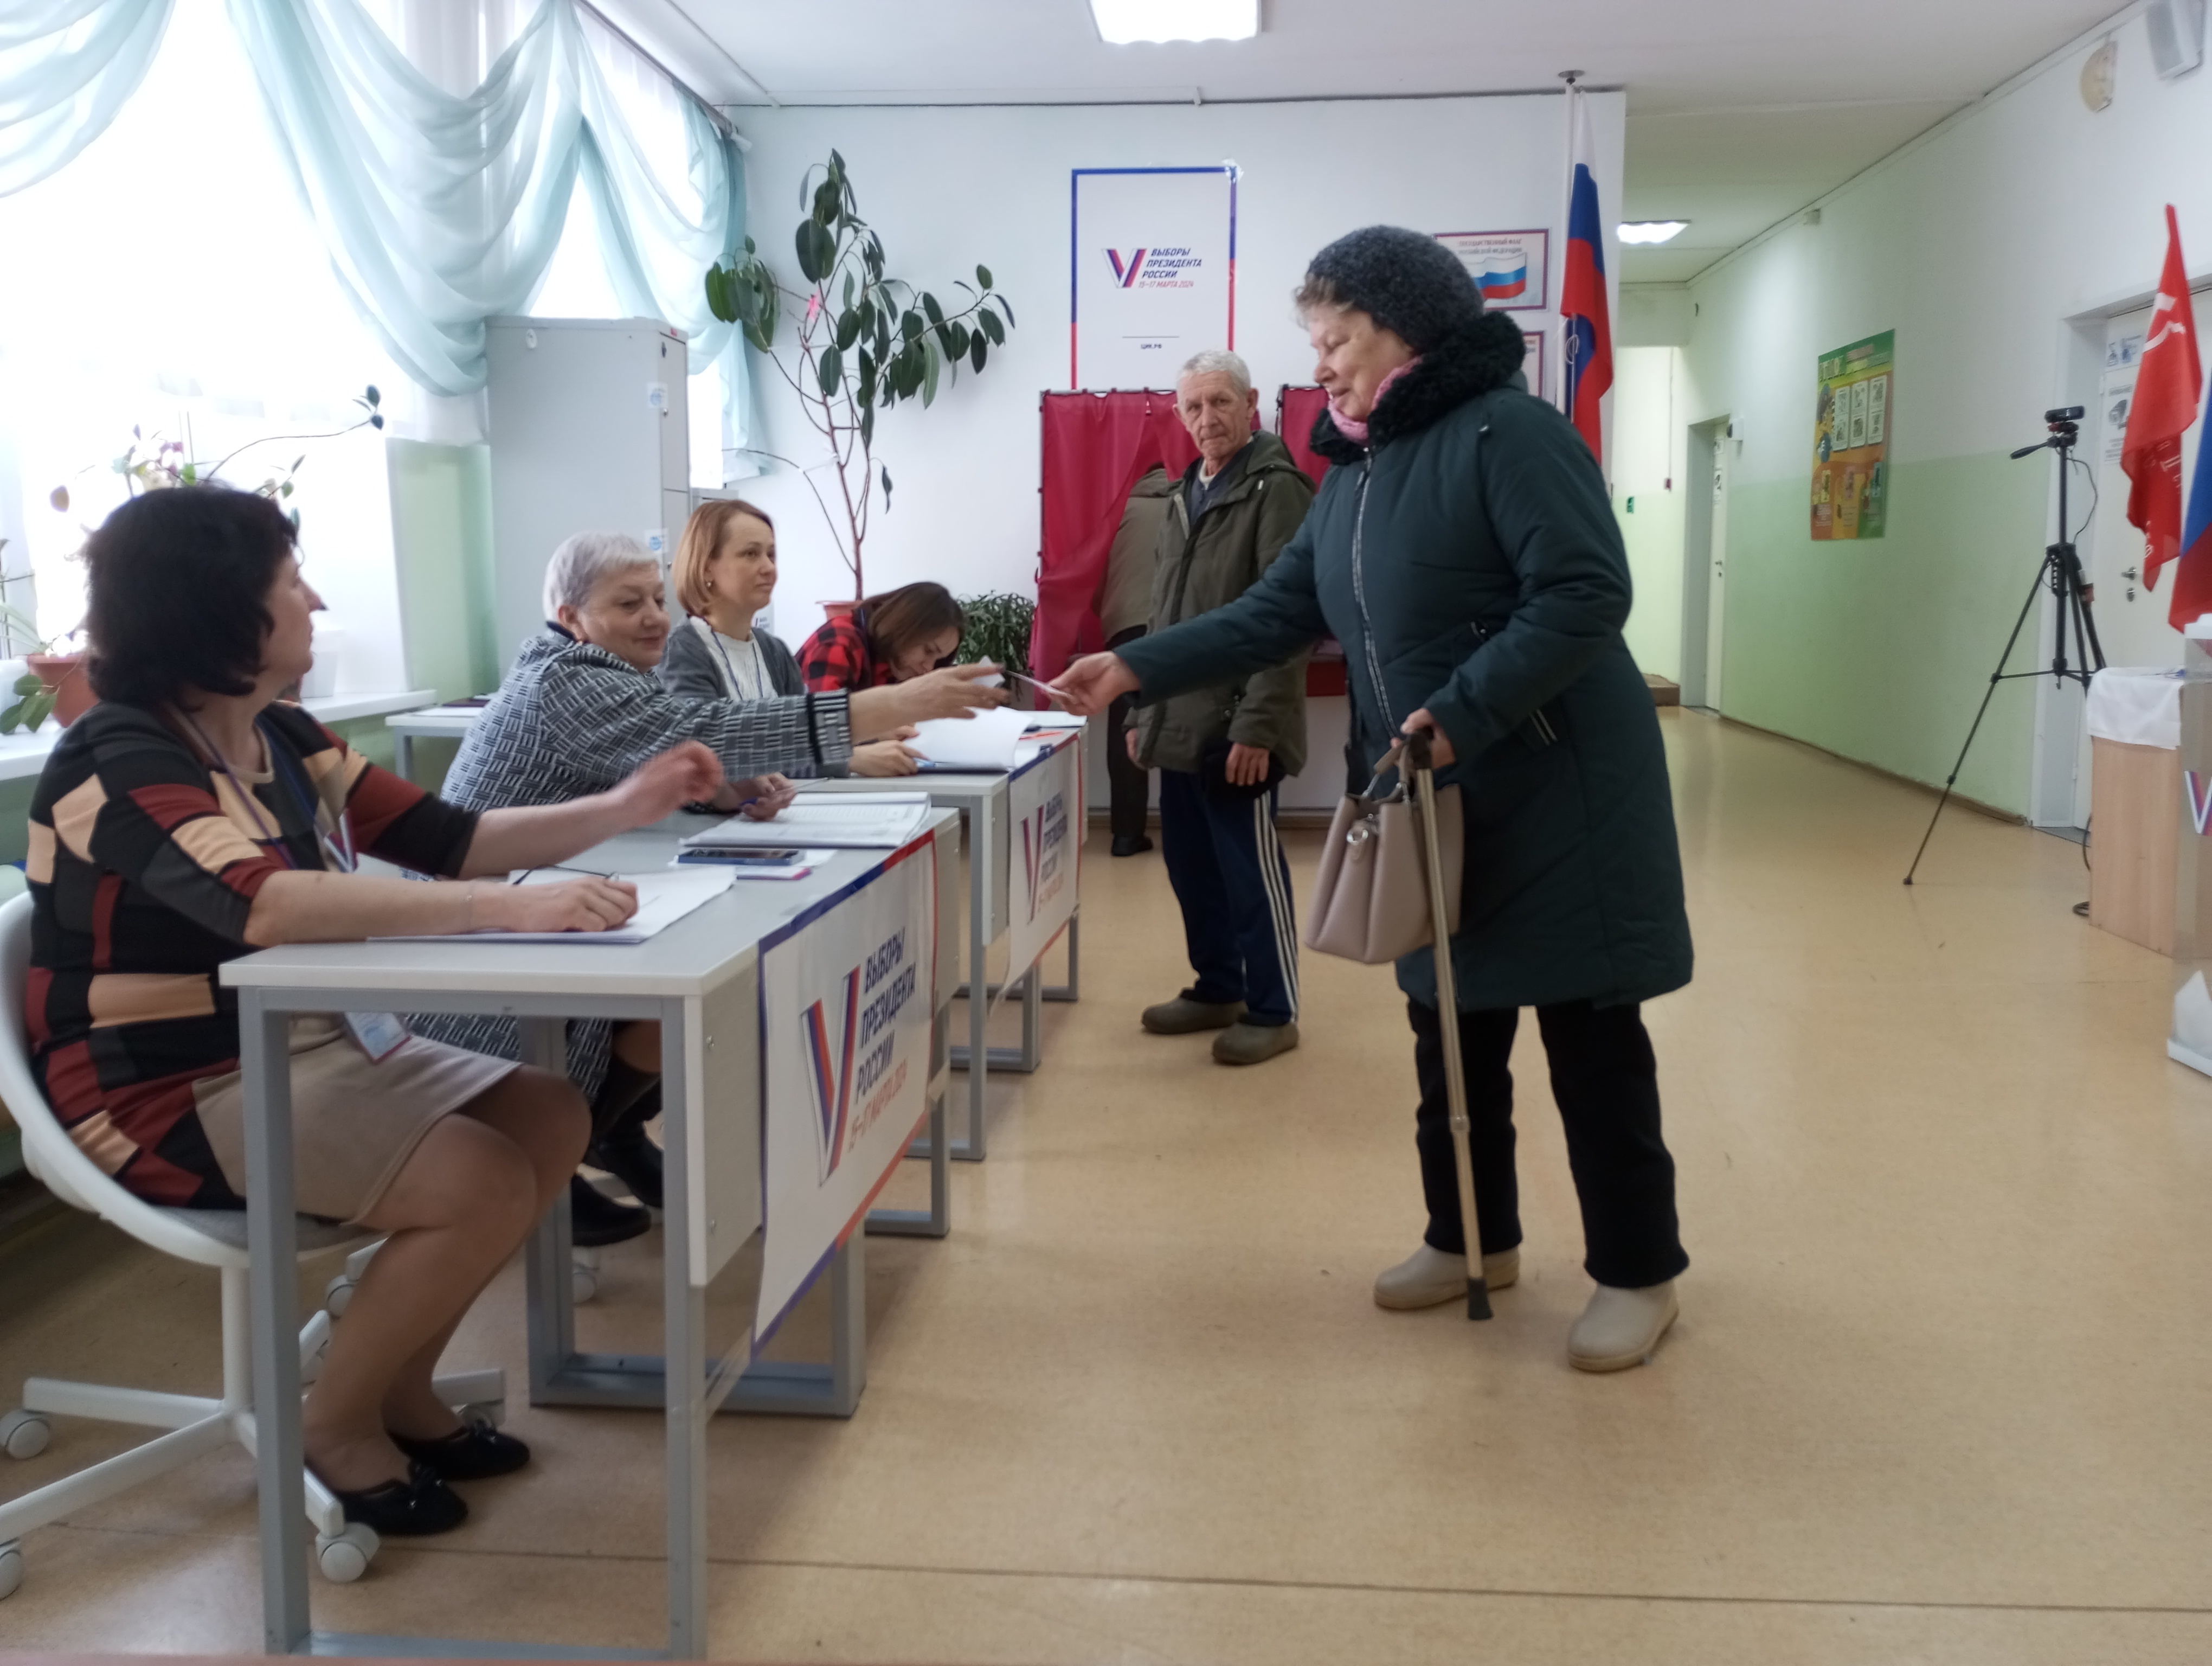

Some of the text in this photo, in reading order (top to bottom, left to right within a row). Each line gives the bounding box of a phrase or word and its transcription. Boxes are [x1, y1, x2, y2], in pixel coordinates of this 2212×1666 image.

[1146, 259, 1202, 268] ПРЕЗИДЕНТА
[1151, 248, 1191, 257] ВЫБОРЫ
[1142, 270, 1178, 279] РОССИИ
[864, 926, 905, 995] ВЫБОРЫ
[860, 962, 916, 1048] ПРЕЗИДЕНТА
[854, 1029, 895, 1105] РОССИИ
